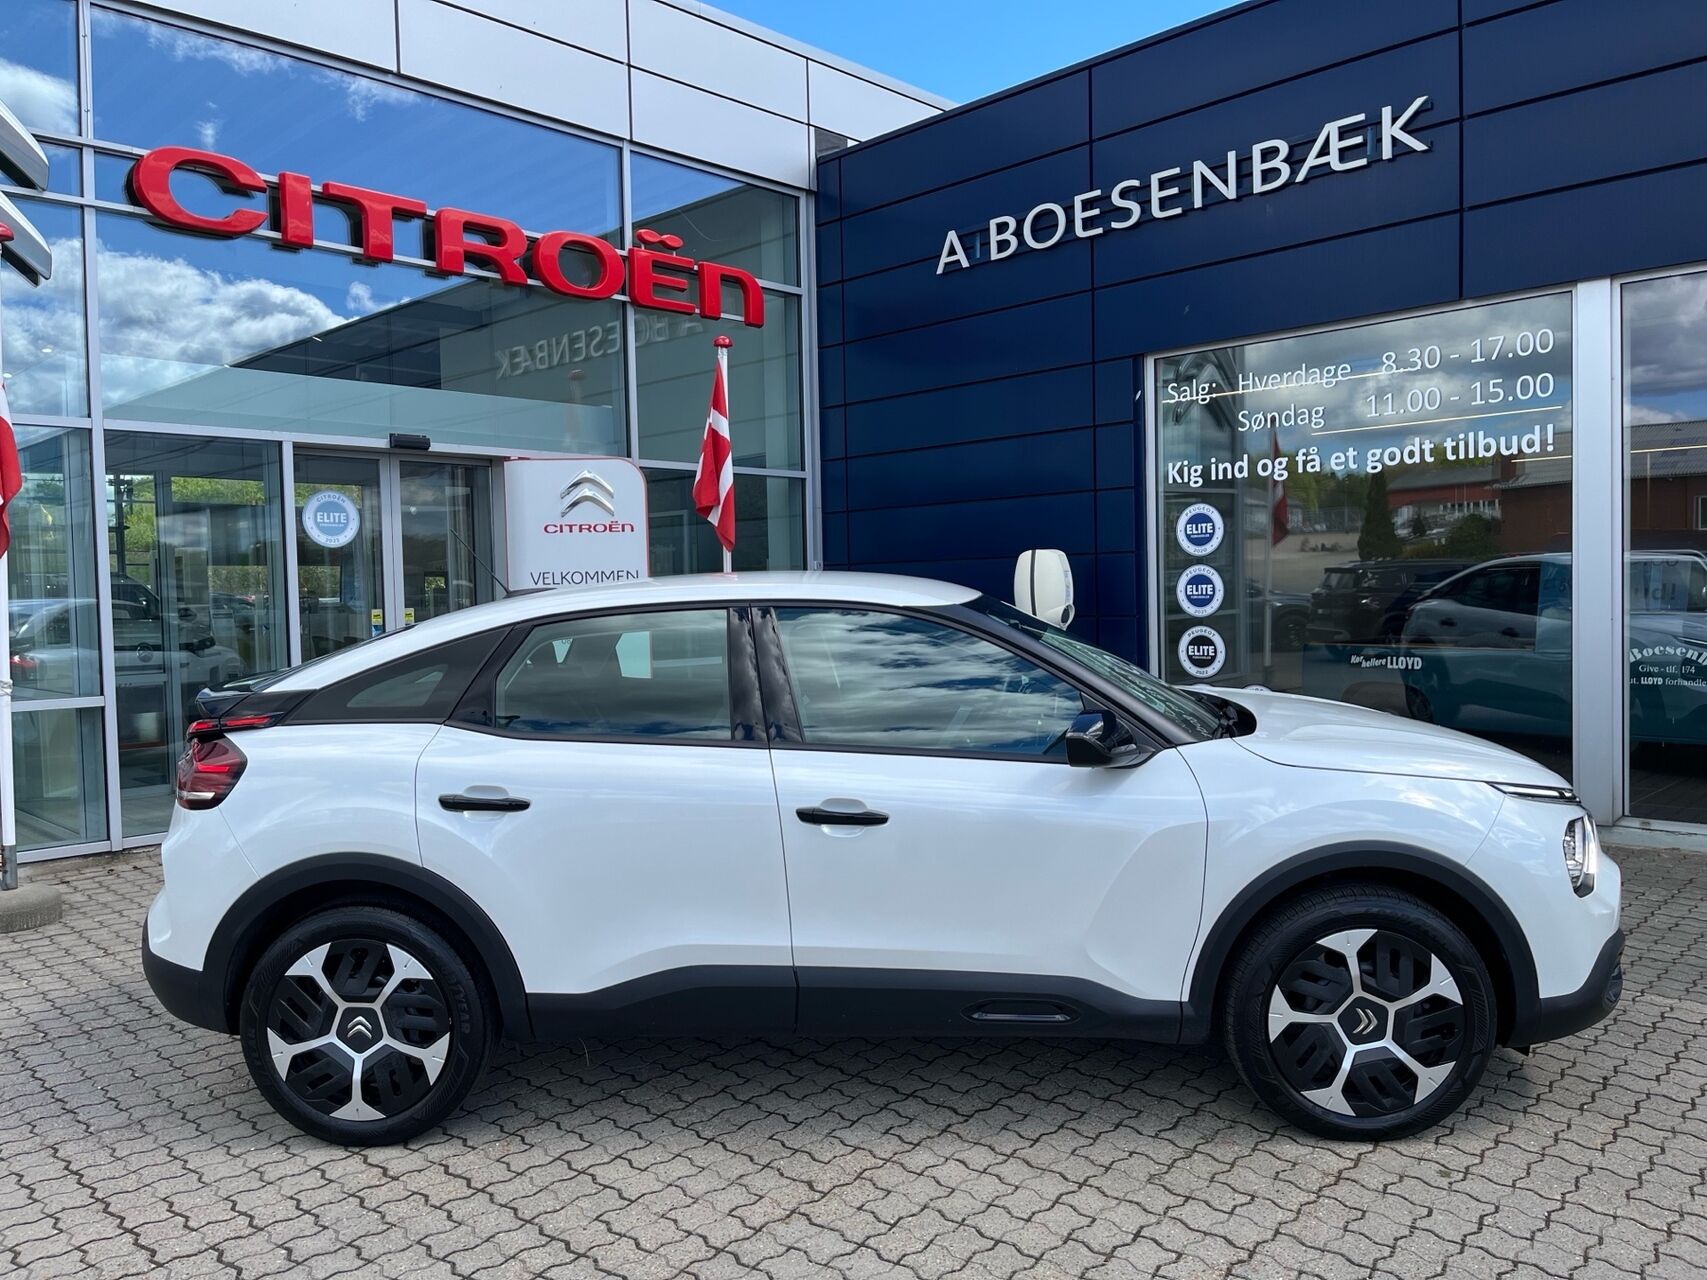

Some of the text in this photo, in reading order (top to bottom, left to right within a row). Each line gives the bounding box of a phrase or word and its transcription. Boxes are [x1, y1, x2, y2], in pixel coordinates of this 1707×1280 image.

[935, 95, 1431, 275] A BOESENBÆK
[130, 145, 765, 329] CITROËN
[1167, 379, 1217, 404] Salg:
[1238, 363, 1352, 394] Hverdage
[1382, 345, 1441, 374] 8.30
[1471, 329, 1554, 363] 17.00
[1238, 404, 1325, 432] Søndag
[1366, 387, 1441, 417] 11.00
[1471, 373, 1554, 406] 15.00
[1168, 424, 1554, 487] Kig ind og få et godt tilbud!
[316, 511, 347, 523] ELITE
[543, 520, 635, 534] CITROËN
[1186, 523, 1213, 534] ELITE
[530, 569, 639, 586] VELKOMMEN
[1185, 566, 1215, 578] PEUGEOT
[1186, 584, 1214, 595] ELITE
[1187, 628, 1216, 638] PEUGEOT
[1188, 645, 1215, 656] ELITE
[1387, 656, 1422, 670] LLOYD
[1638, 664, 1659, 673] Give
[1681, 665, 1695, 674] 174
[1640, 677, 1663, 685] LLOYD
